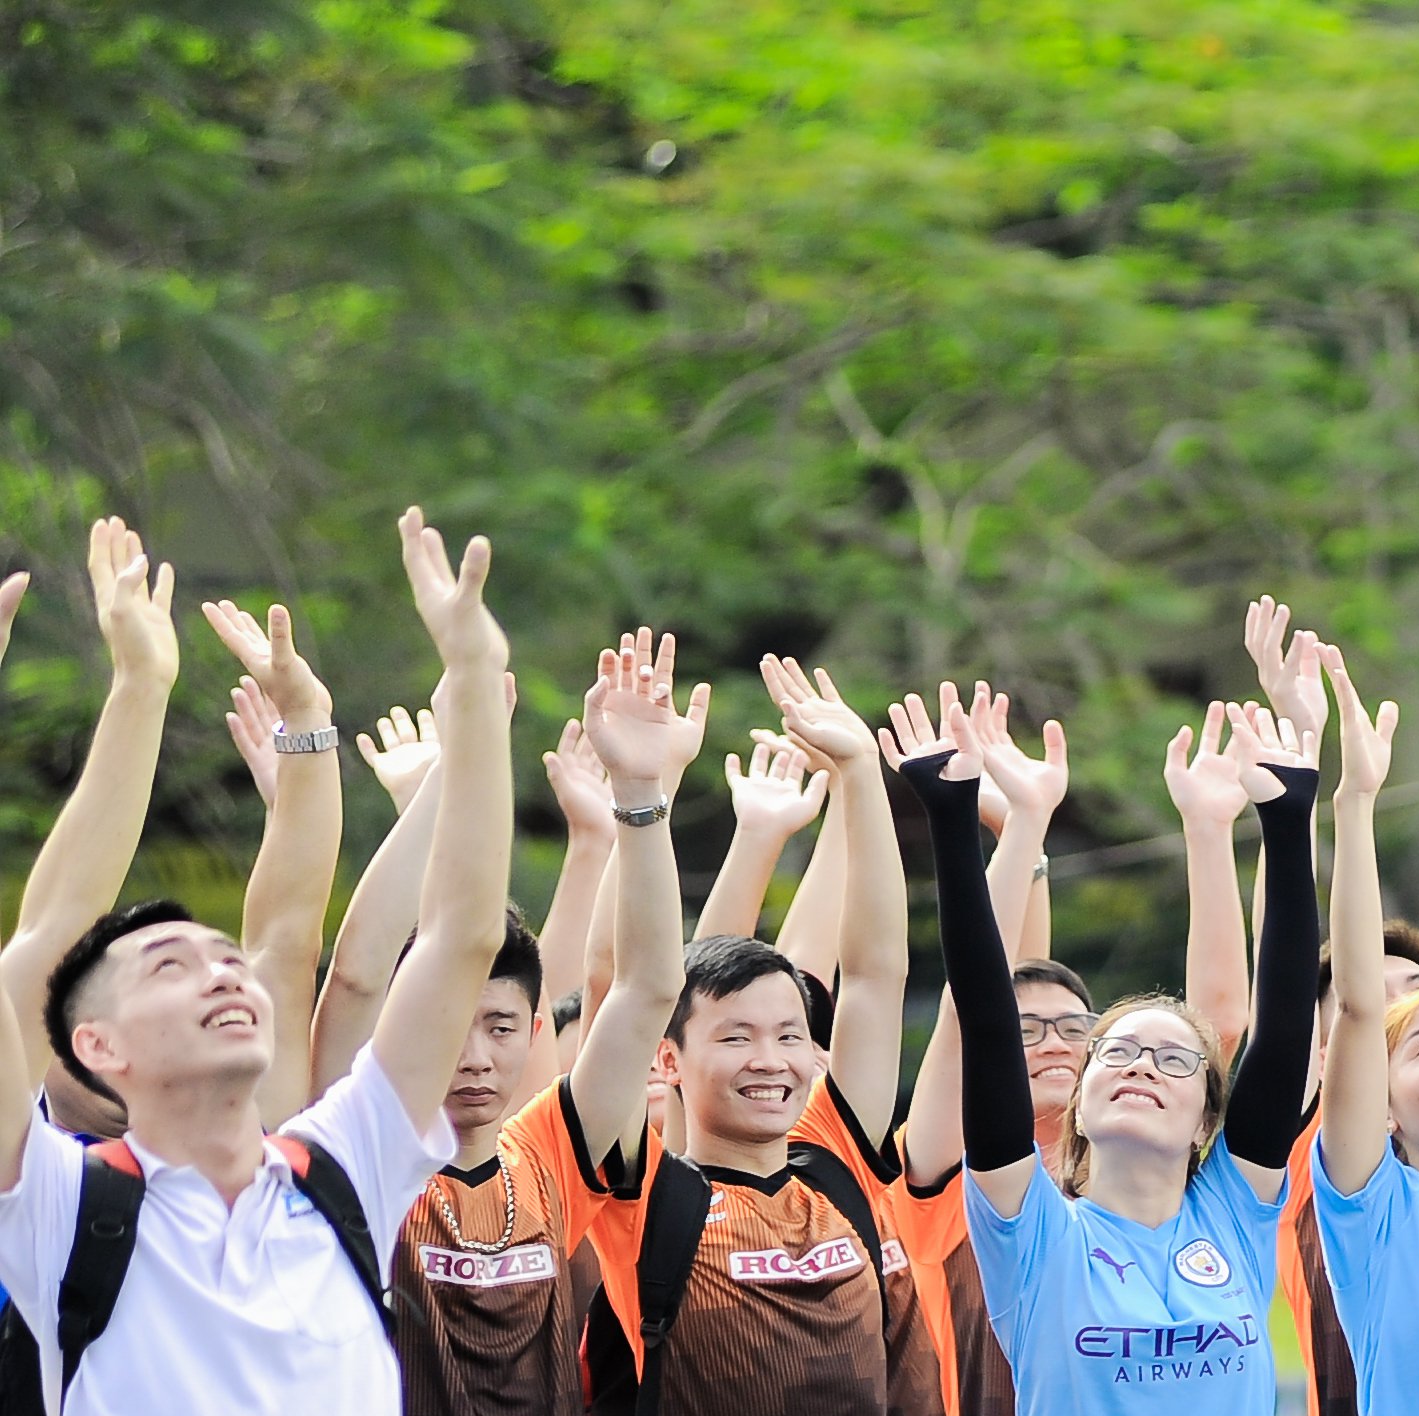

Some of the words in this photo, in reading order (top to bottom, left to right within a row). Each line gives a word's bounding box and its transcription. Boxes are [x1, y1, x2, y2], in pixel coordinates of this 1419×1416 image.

[425, 1251, 546, 1280] RORZE
[1075, 1313, 1260, 1358] ETIHAD
[1114, 1354, 1245, 1383] AIRWAYS
